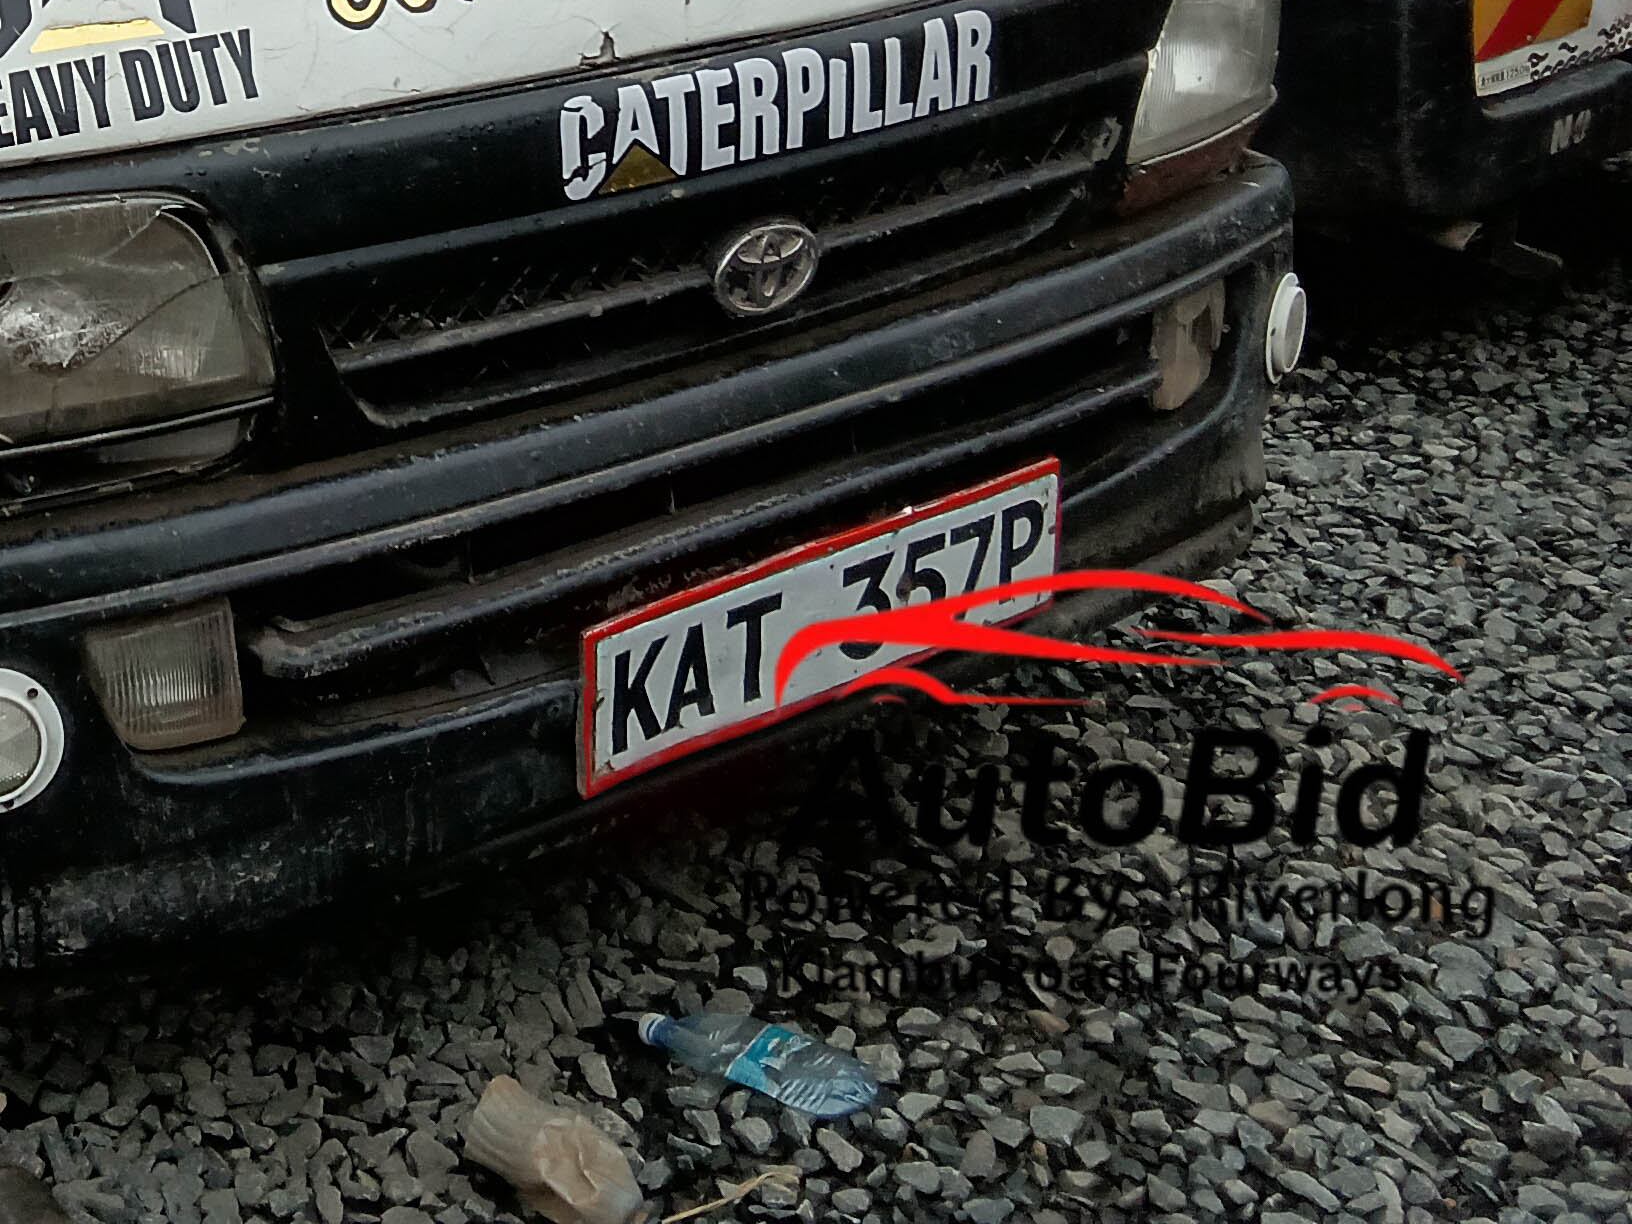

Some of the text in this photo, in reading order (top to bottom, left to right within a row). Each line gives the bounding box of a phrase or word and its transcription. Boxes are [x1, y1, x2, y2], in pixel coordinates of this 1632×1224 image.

[119, 28, 259, 122] DUTY
[559, 9, 992, 200] CATERPILLAR
[611, 499, 1044, 756] KAT 357P
